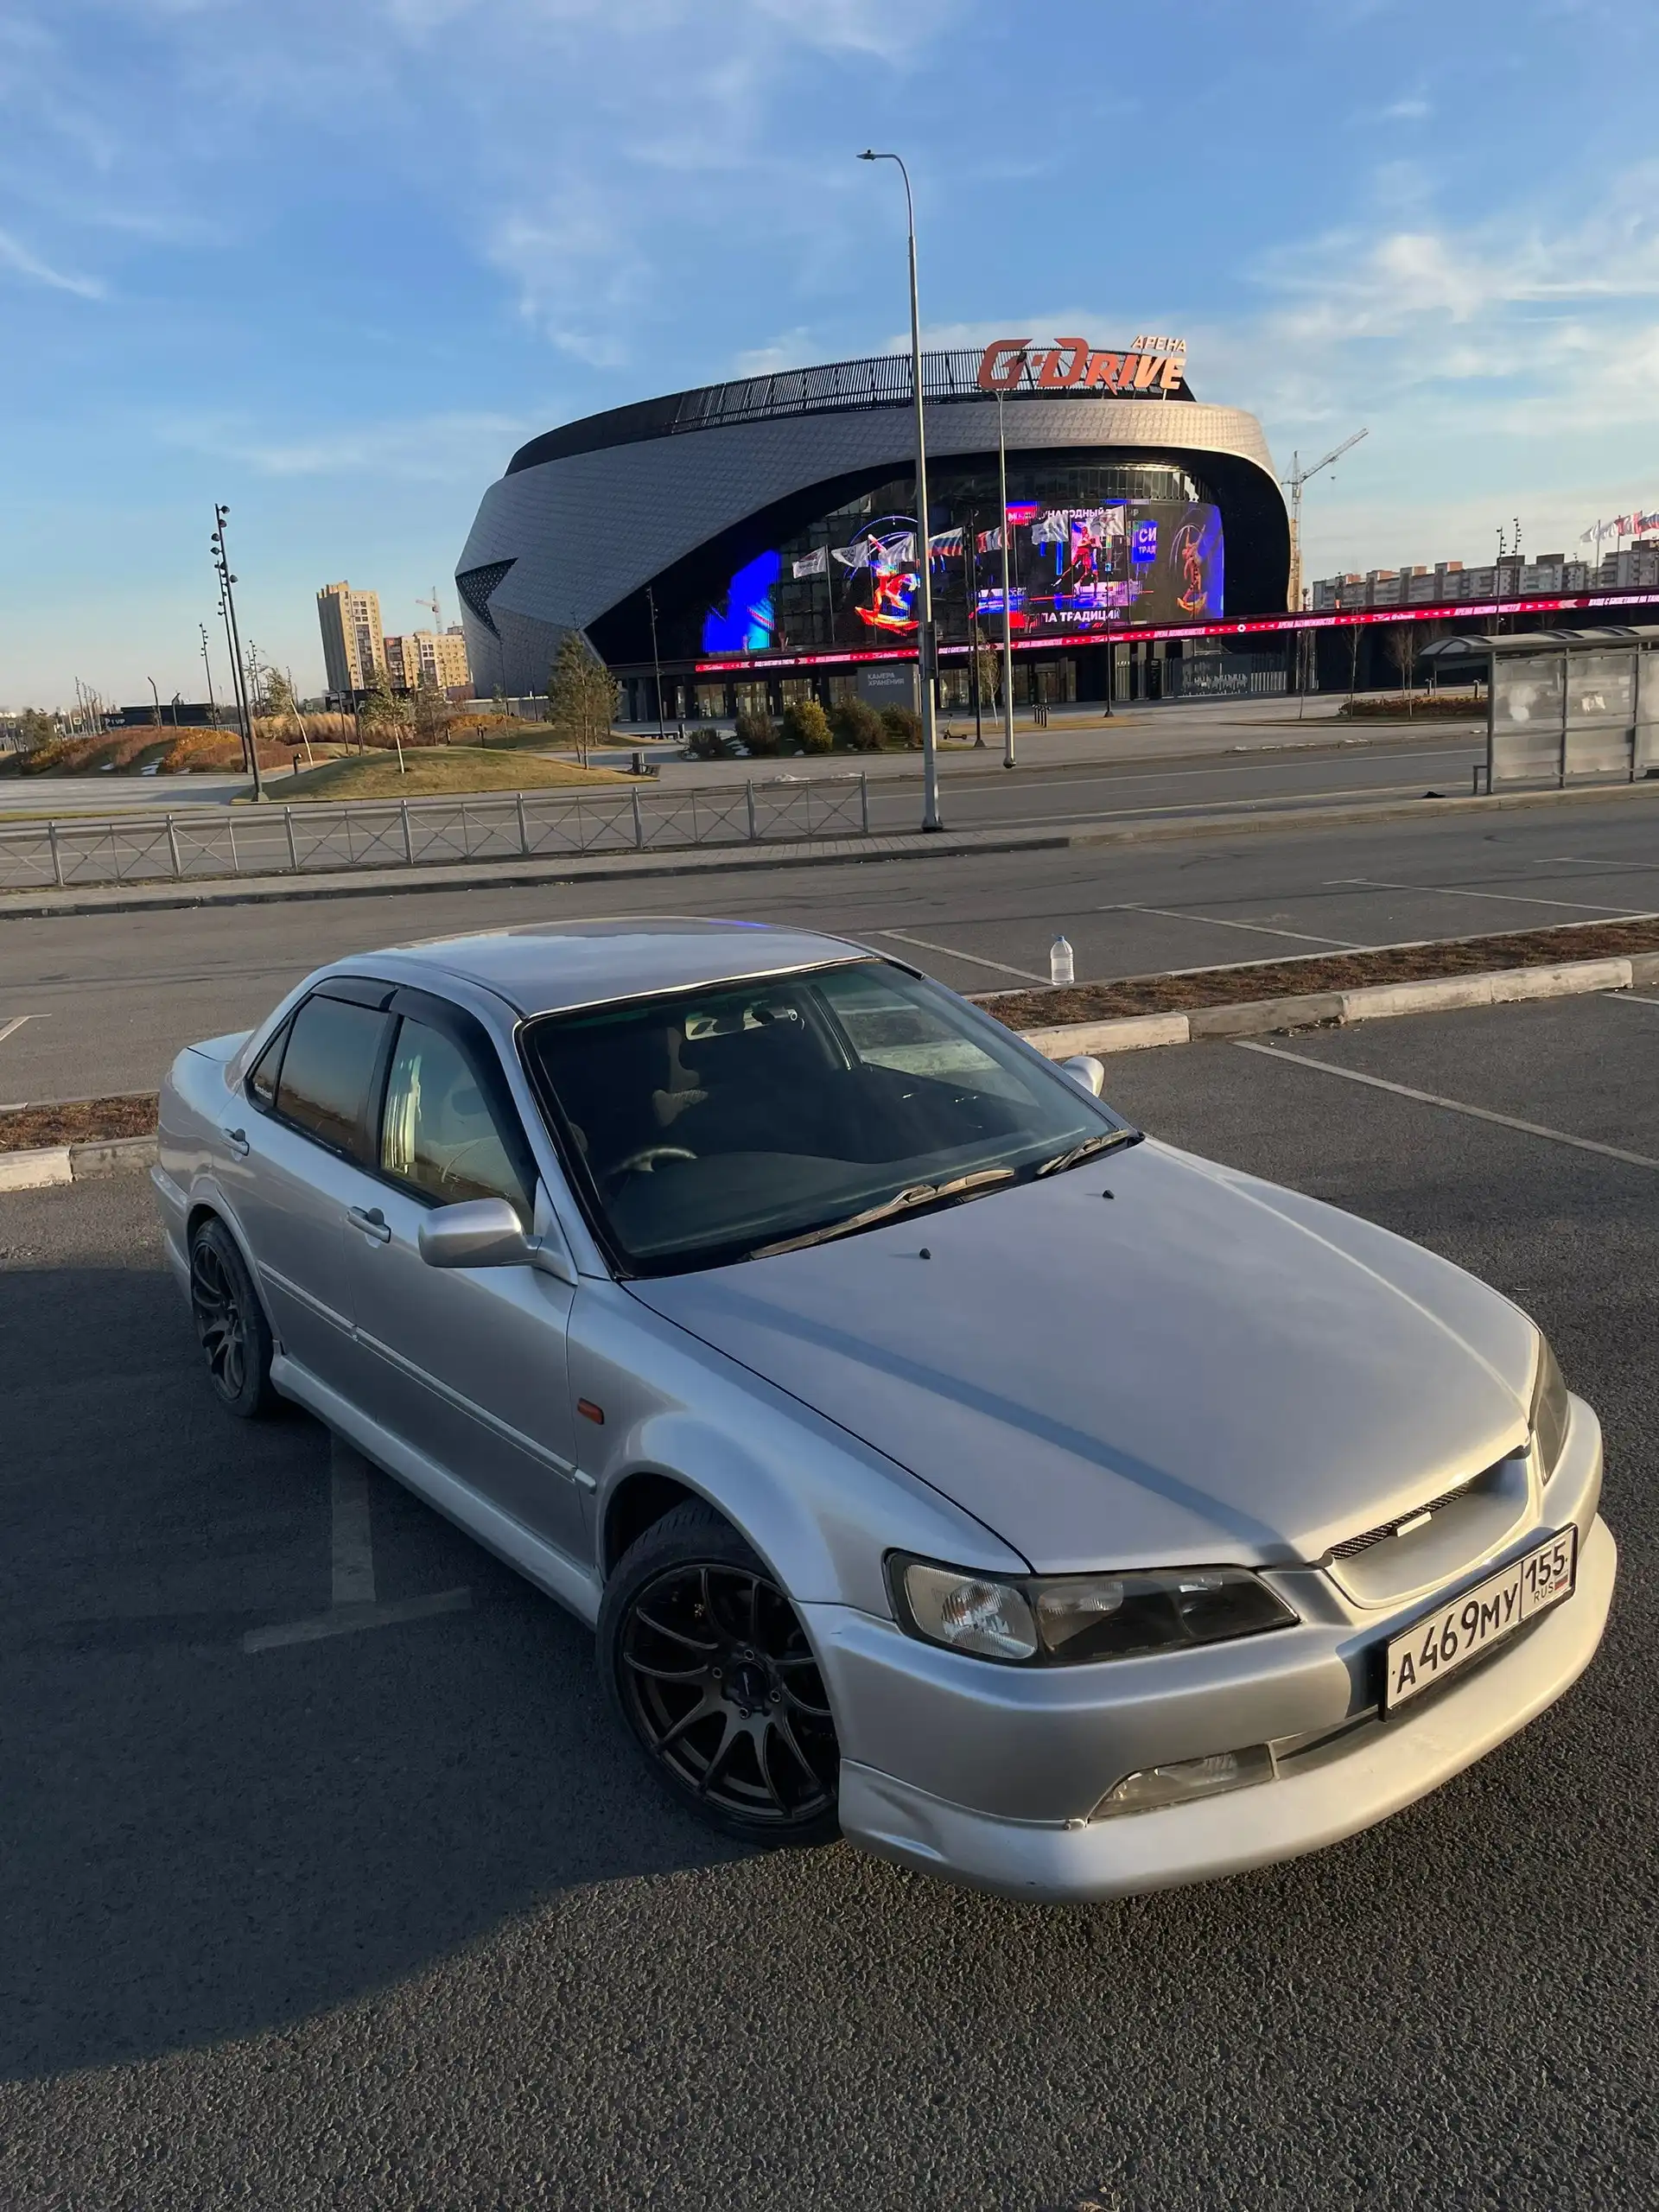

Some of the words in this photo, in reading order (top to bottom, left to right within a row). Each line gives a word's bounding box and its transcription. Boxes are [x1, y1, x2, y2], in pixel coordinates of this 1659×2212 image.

[1131, 335, 1187, 353] АРЕНА
[1533, 1581, 1554, 1605] RUS
[1395, 1581, 1518, 1694] А469МУ
[1524, 1538, 1567, 1593] 155
